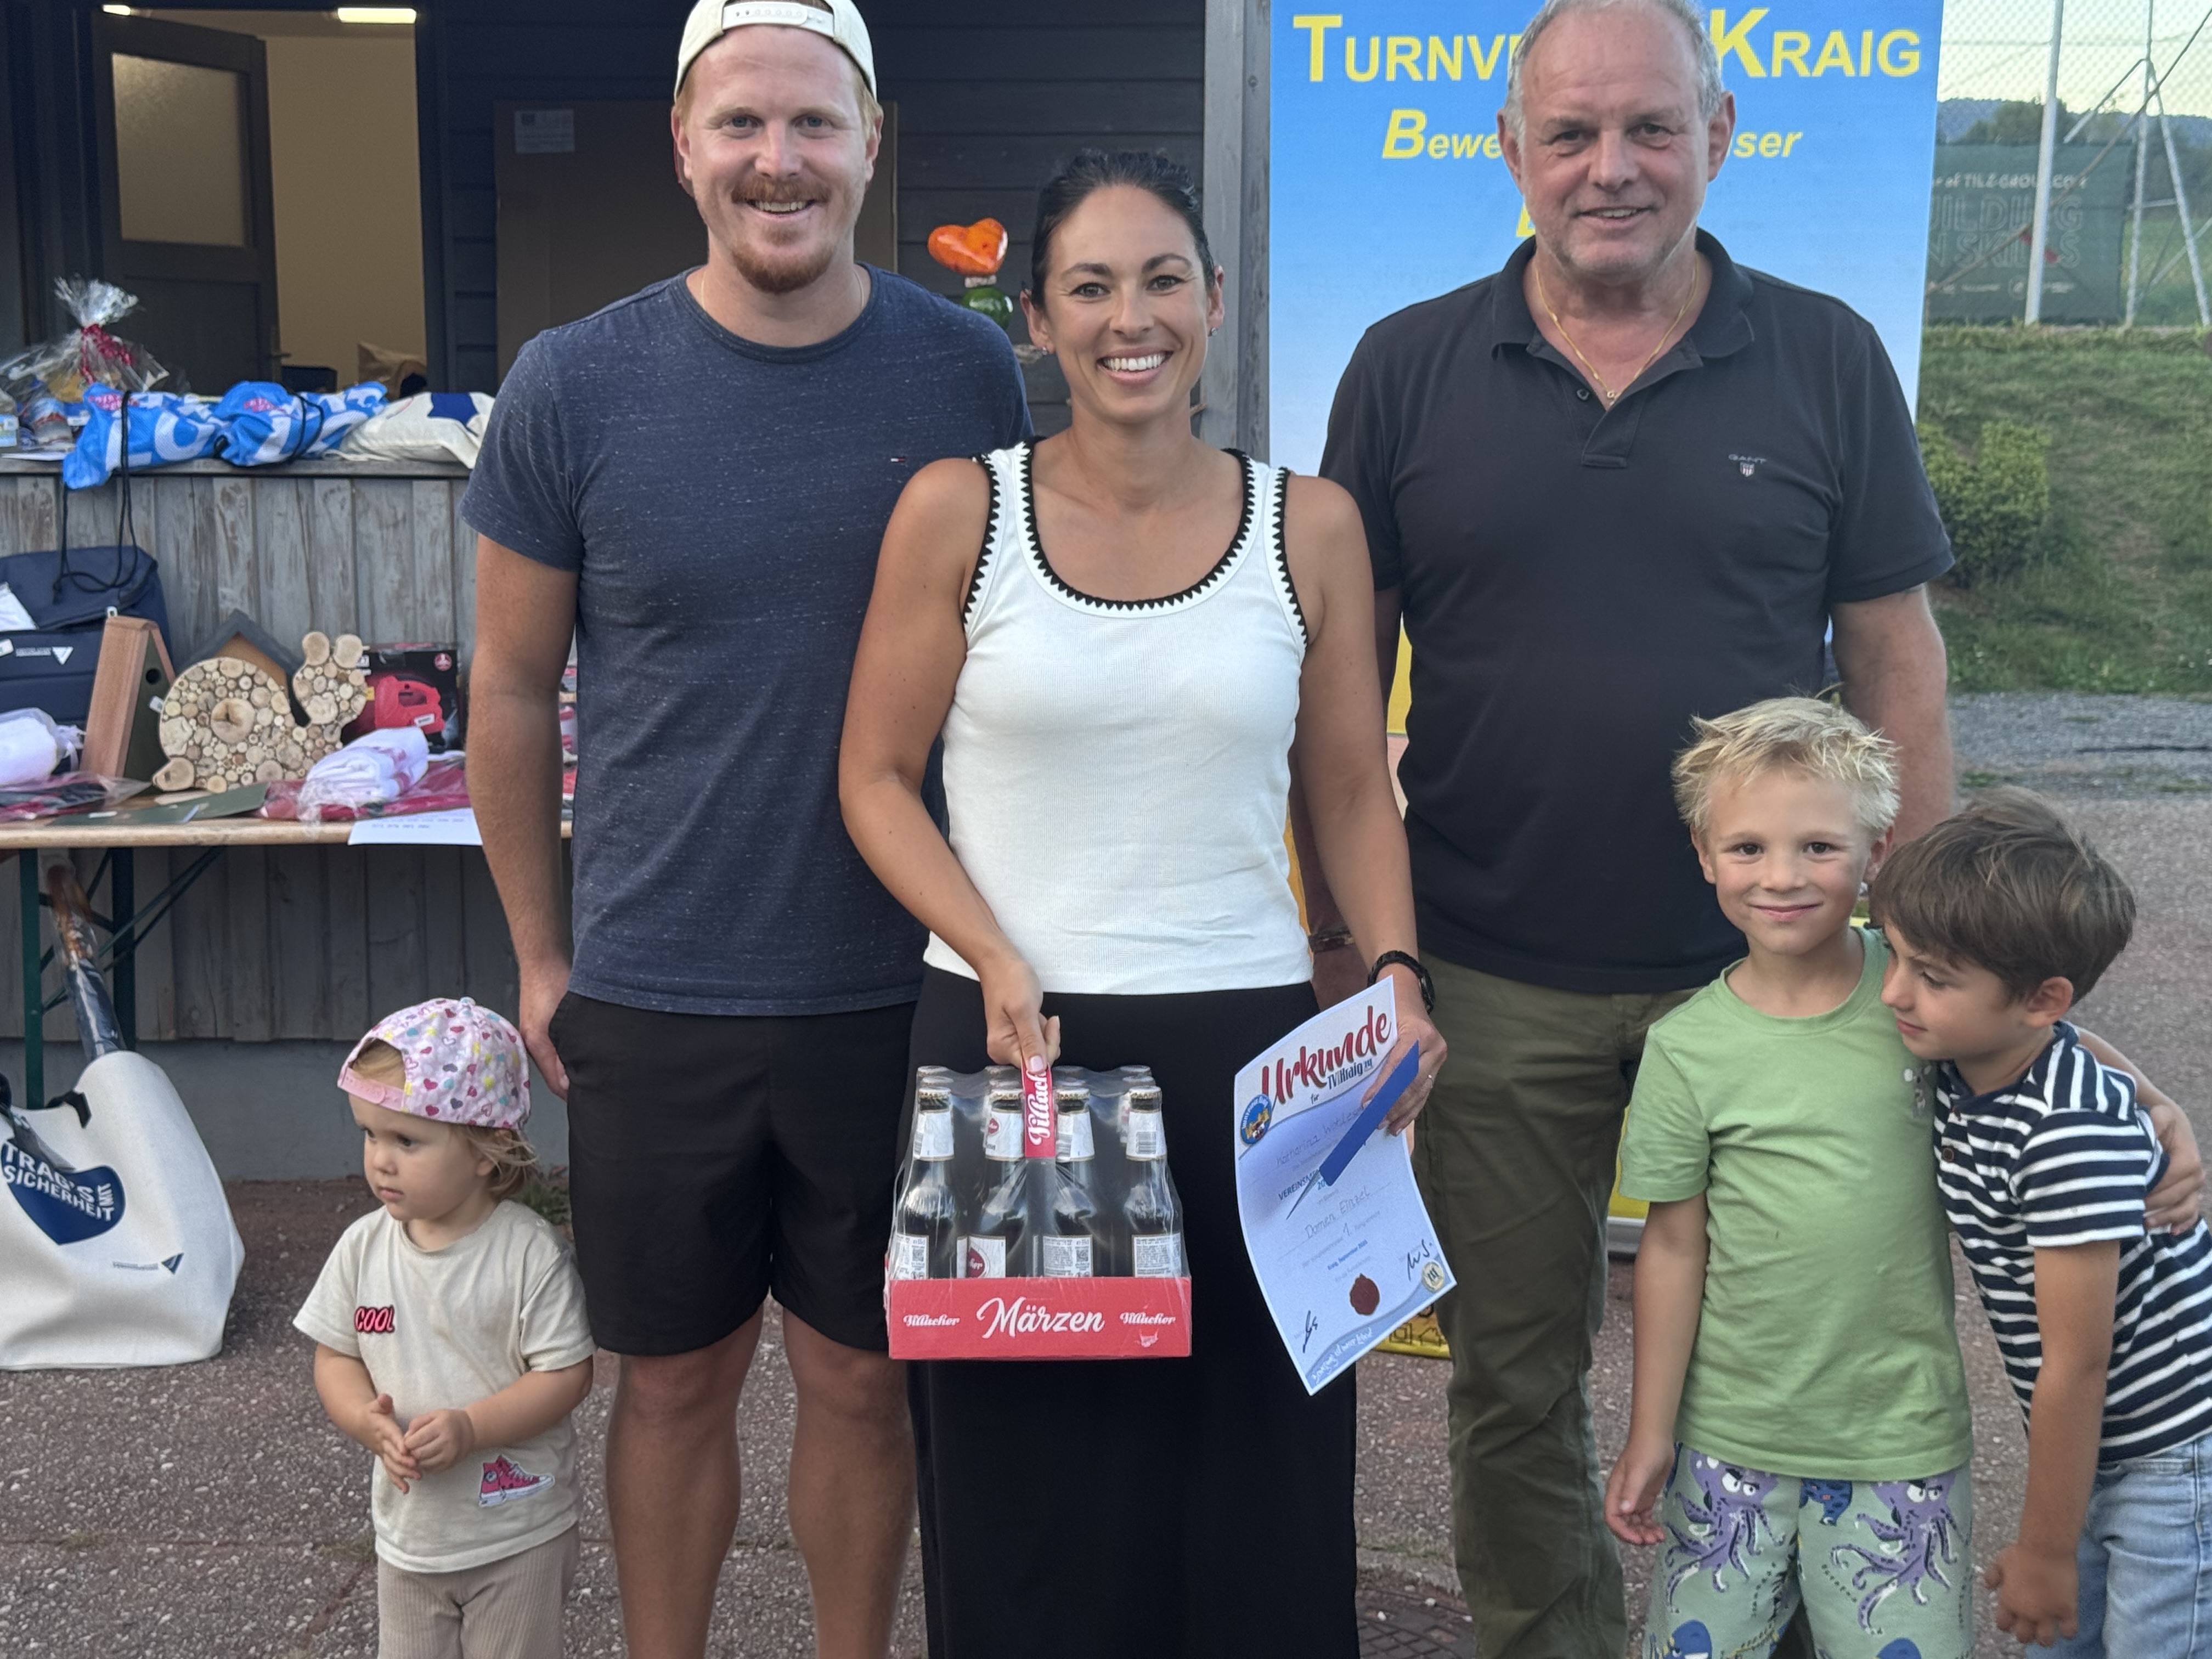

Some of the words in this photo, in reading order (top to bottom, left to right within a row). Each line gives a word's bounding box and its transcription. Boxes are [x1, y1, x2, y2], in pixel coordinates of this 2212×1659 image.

[1293, 14, 1519, 82] TURNV
[1710, 8, 1920, 77] KRAIG
[1383, 109, 1504, 159] Bewe
[1728, 131, 1803, 157] ser
[1262, 1005, 1392, 1104] Urkunde
[1025, 1070, 1050, 1146] Villach
[4, 1165, 114, 1221] SICHERHEIT
[354, 1305, 394, 1333] COOL
[977, 1296, 1105, 1339] Märzen
